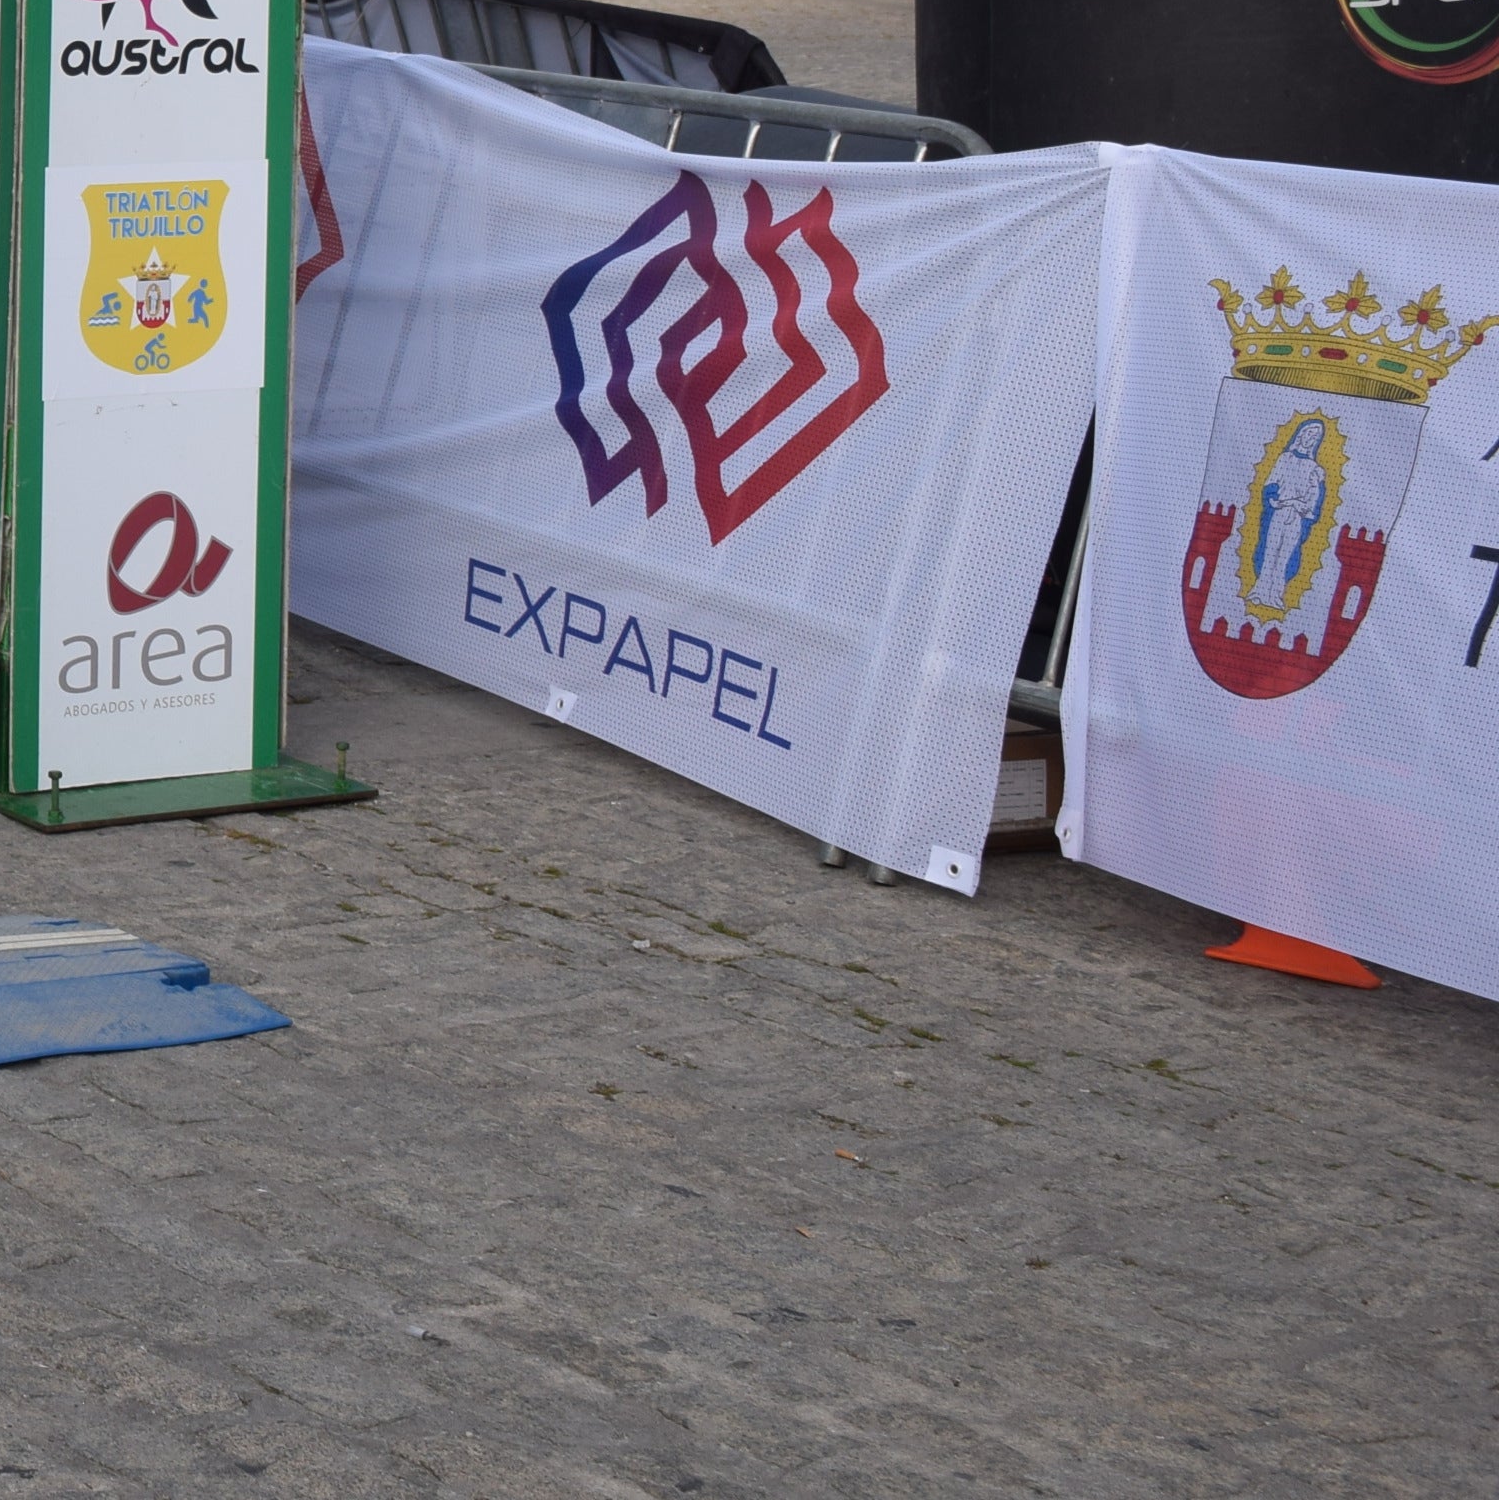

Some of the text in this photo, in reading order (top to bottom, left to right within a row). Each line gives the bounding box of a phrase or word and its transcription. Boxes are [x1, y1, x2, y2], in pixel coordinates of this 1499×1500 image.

[60, 37, 260, 77] austral
[105, 186, 209, 215] TRIATLÓN
[108, 214, 205, 240] TRUJILLO
[58, 623, 234, 695] area
[463, 557, 793, 751] EXPAPEL
[63, 692, 216, 718] ABOGADOS Y ASESORES
